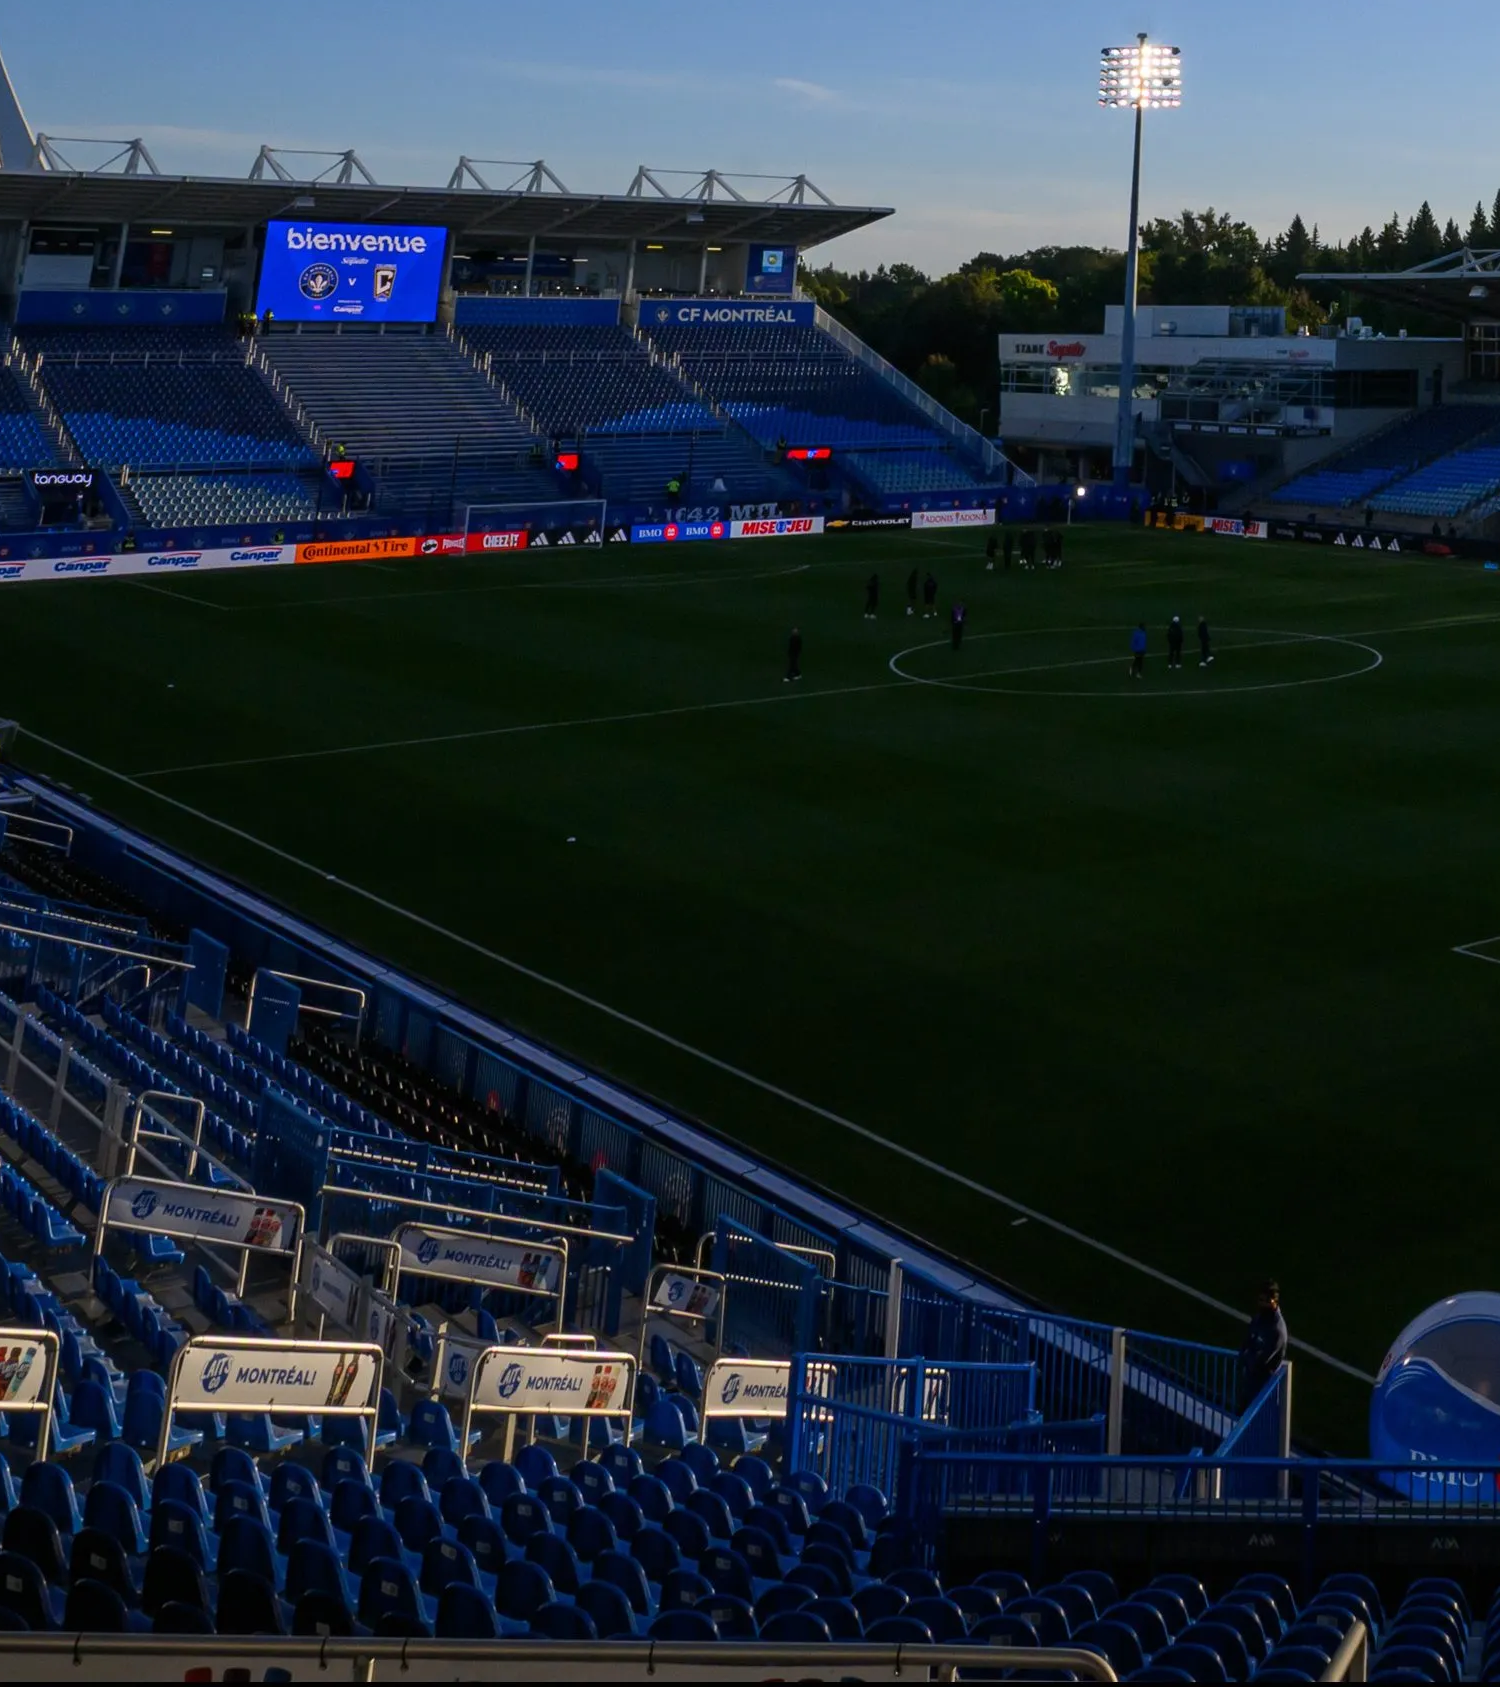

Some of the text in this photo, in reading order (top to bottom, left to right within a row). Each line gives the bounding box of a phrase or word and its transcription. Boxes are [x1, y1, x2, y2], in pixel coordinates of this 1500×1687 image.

[287, 227, 427, 253] bienvenue
[677, 306, 796, 322] CF MONTRÉAL
[1015, 344, 1044, 354] STADE
[34, 472, 93, 488] tanguay
[742, 519, 813, 534] MISE JEU
[852, 516, 911, 527] CHEVROLET
[924, 514, 953, 523] ADONIS
[639, 526, 708, 538] BMO BMO
[231, 551, 282, 561] Canpar
[303, 541, 408, 560] Continental Tire
[54, 561, 110, 573] Canpar
[148, 555, 201, 568] Canpar
[162, 1203, 241, 1227] MONTRÉAL!
[444, 1248, 512, 1272] MONTRÉAL!
[236, 1366, 319, 1387] MONTRÉAL!
[525, 1375, 584, 1393] MONTRÉAL!
[1409, 1449, 1484, 1488] BMO
